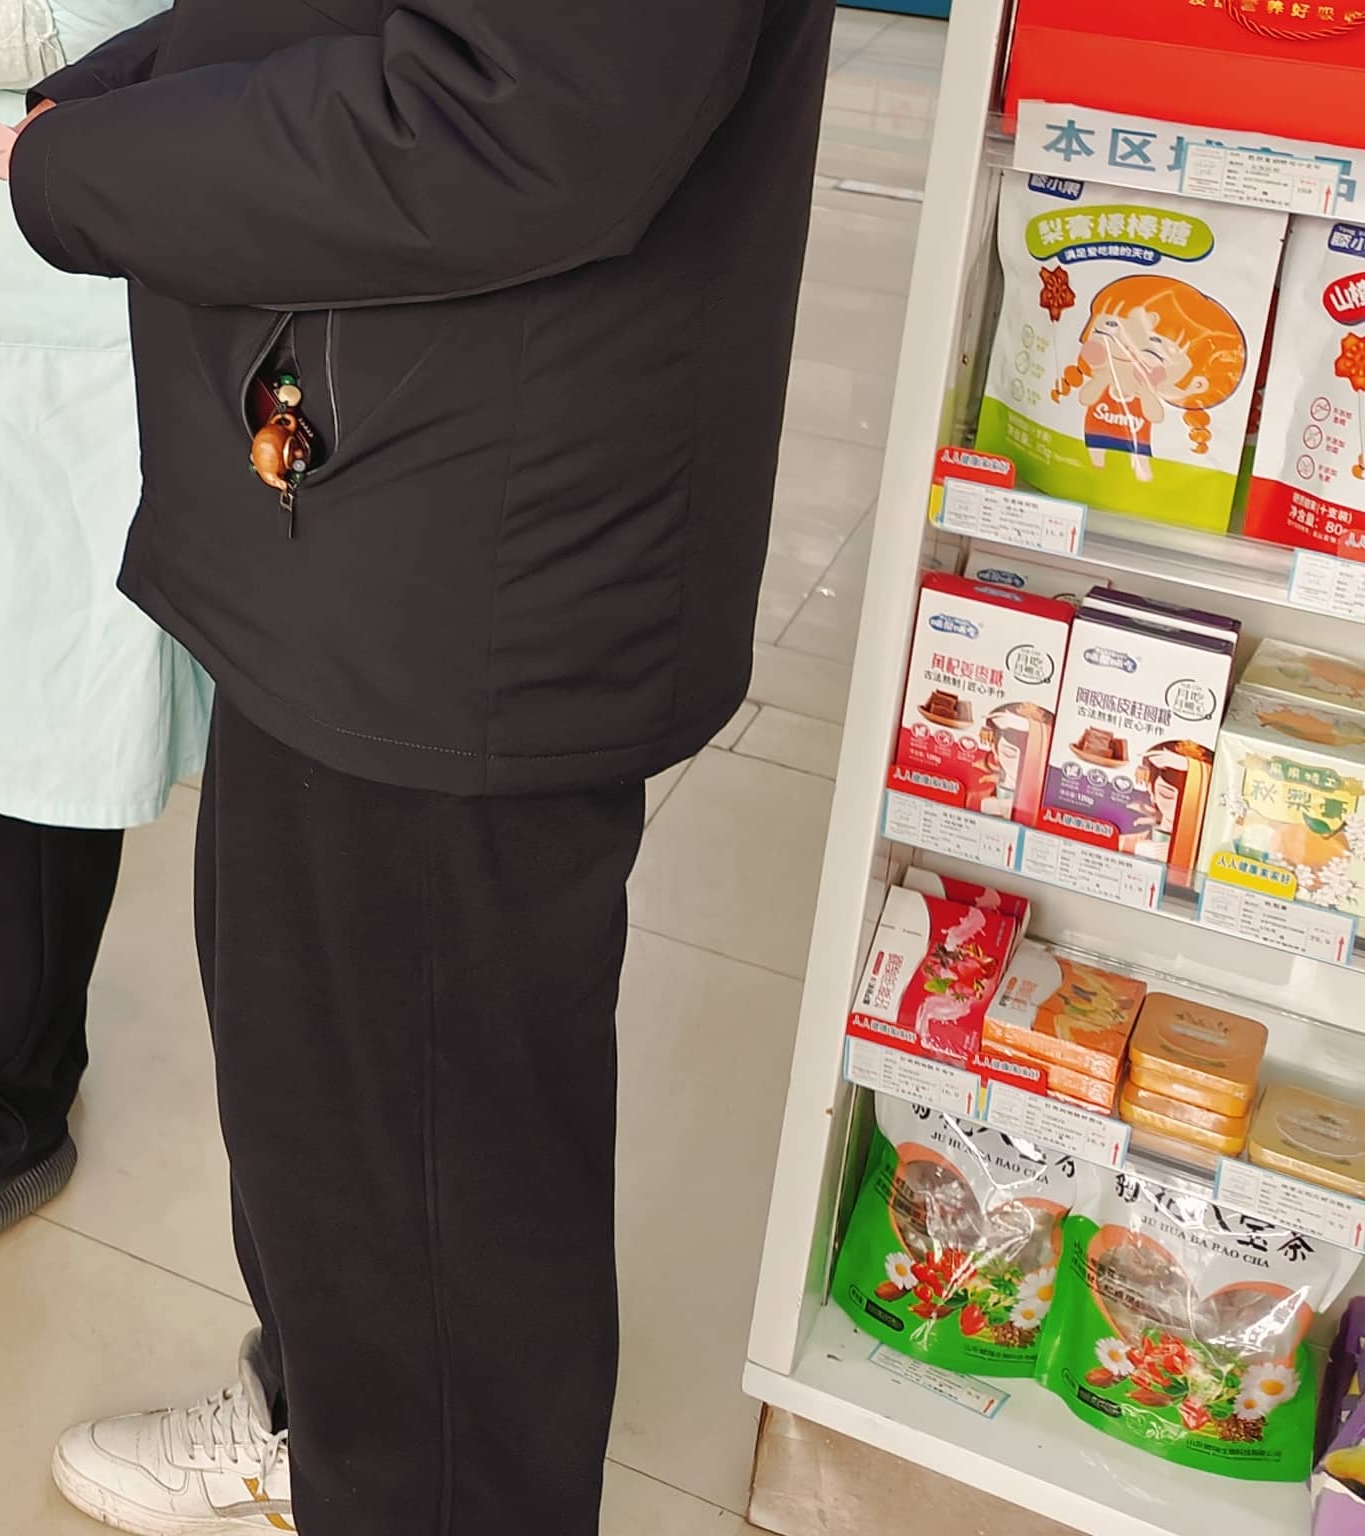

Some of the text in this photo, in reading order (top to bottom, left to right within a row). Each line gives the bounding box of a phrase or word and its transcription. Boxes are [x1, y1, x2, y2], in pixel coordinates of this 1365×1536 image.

[1037, 213, 1193, 248] 梨膏棒棒糖
[1092, 403, 1145, 432] Sunny
[1159, 1219, 1187, 1240] HUA
[1242, 1252, 1271, 1269] CHA
